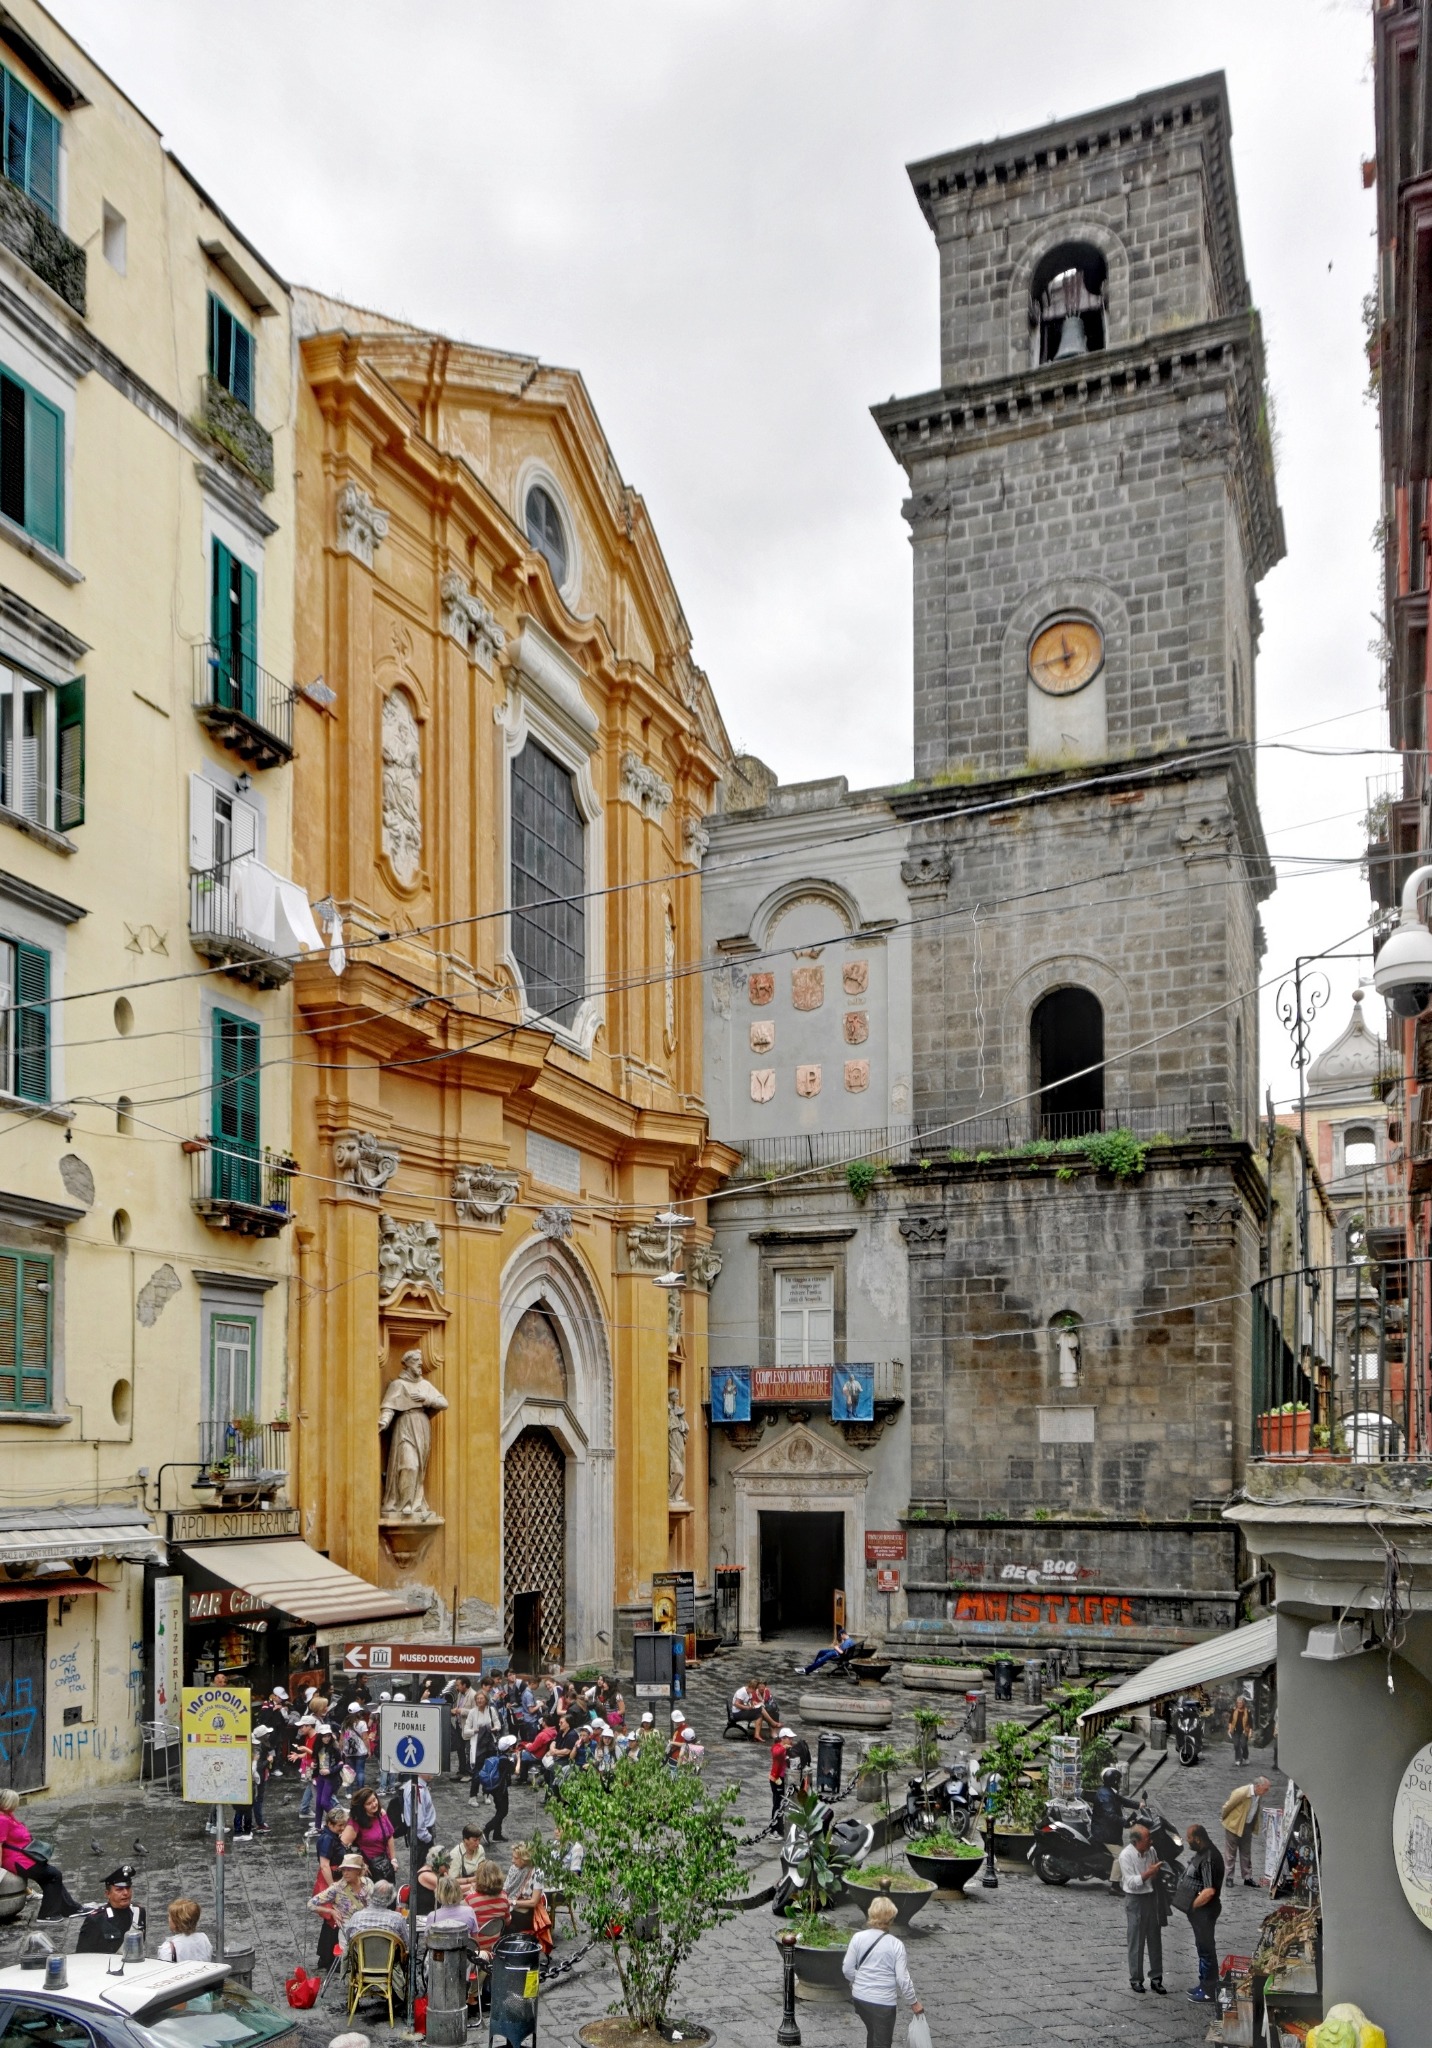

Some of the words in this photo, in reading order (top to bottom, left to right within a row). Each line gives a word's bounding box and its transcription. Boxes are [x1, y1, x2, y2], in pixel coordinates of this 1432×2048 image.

[755, 1370, 787, 1384] COMPLESSO
[788, 1369, 829, 1383] MONUMENTALE
[755, 1383, 767, 1397] SAN
[768, 1383, 796, 1397] LORENZO
[797, 1382, 829, 1396] MAGGIORE
[190, 1592, 223, 1617] BAR
[399, 1653, 427, 1663] MUSEO
[428, 1654, 475, 1665] DIOCESANO
[187, 1690, 248, 1714] INFOPOINT
[401, 1709, 419, 1719] AREA
[393, 1722, 426, 1732] PEDONALE
